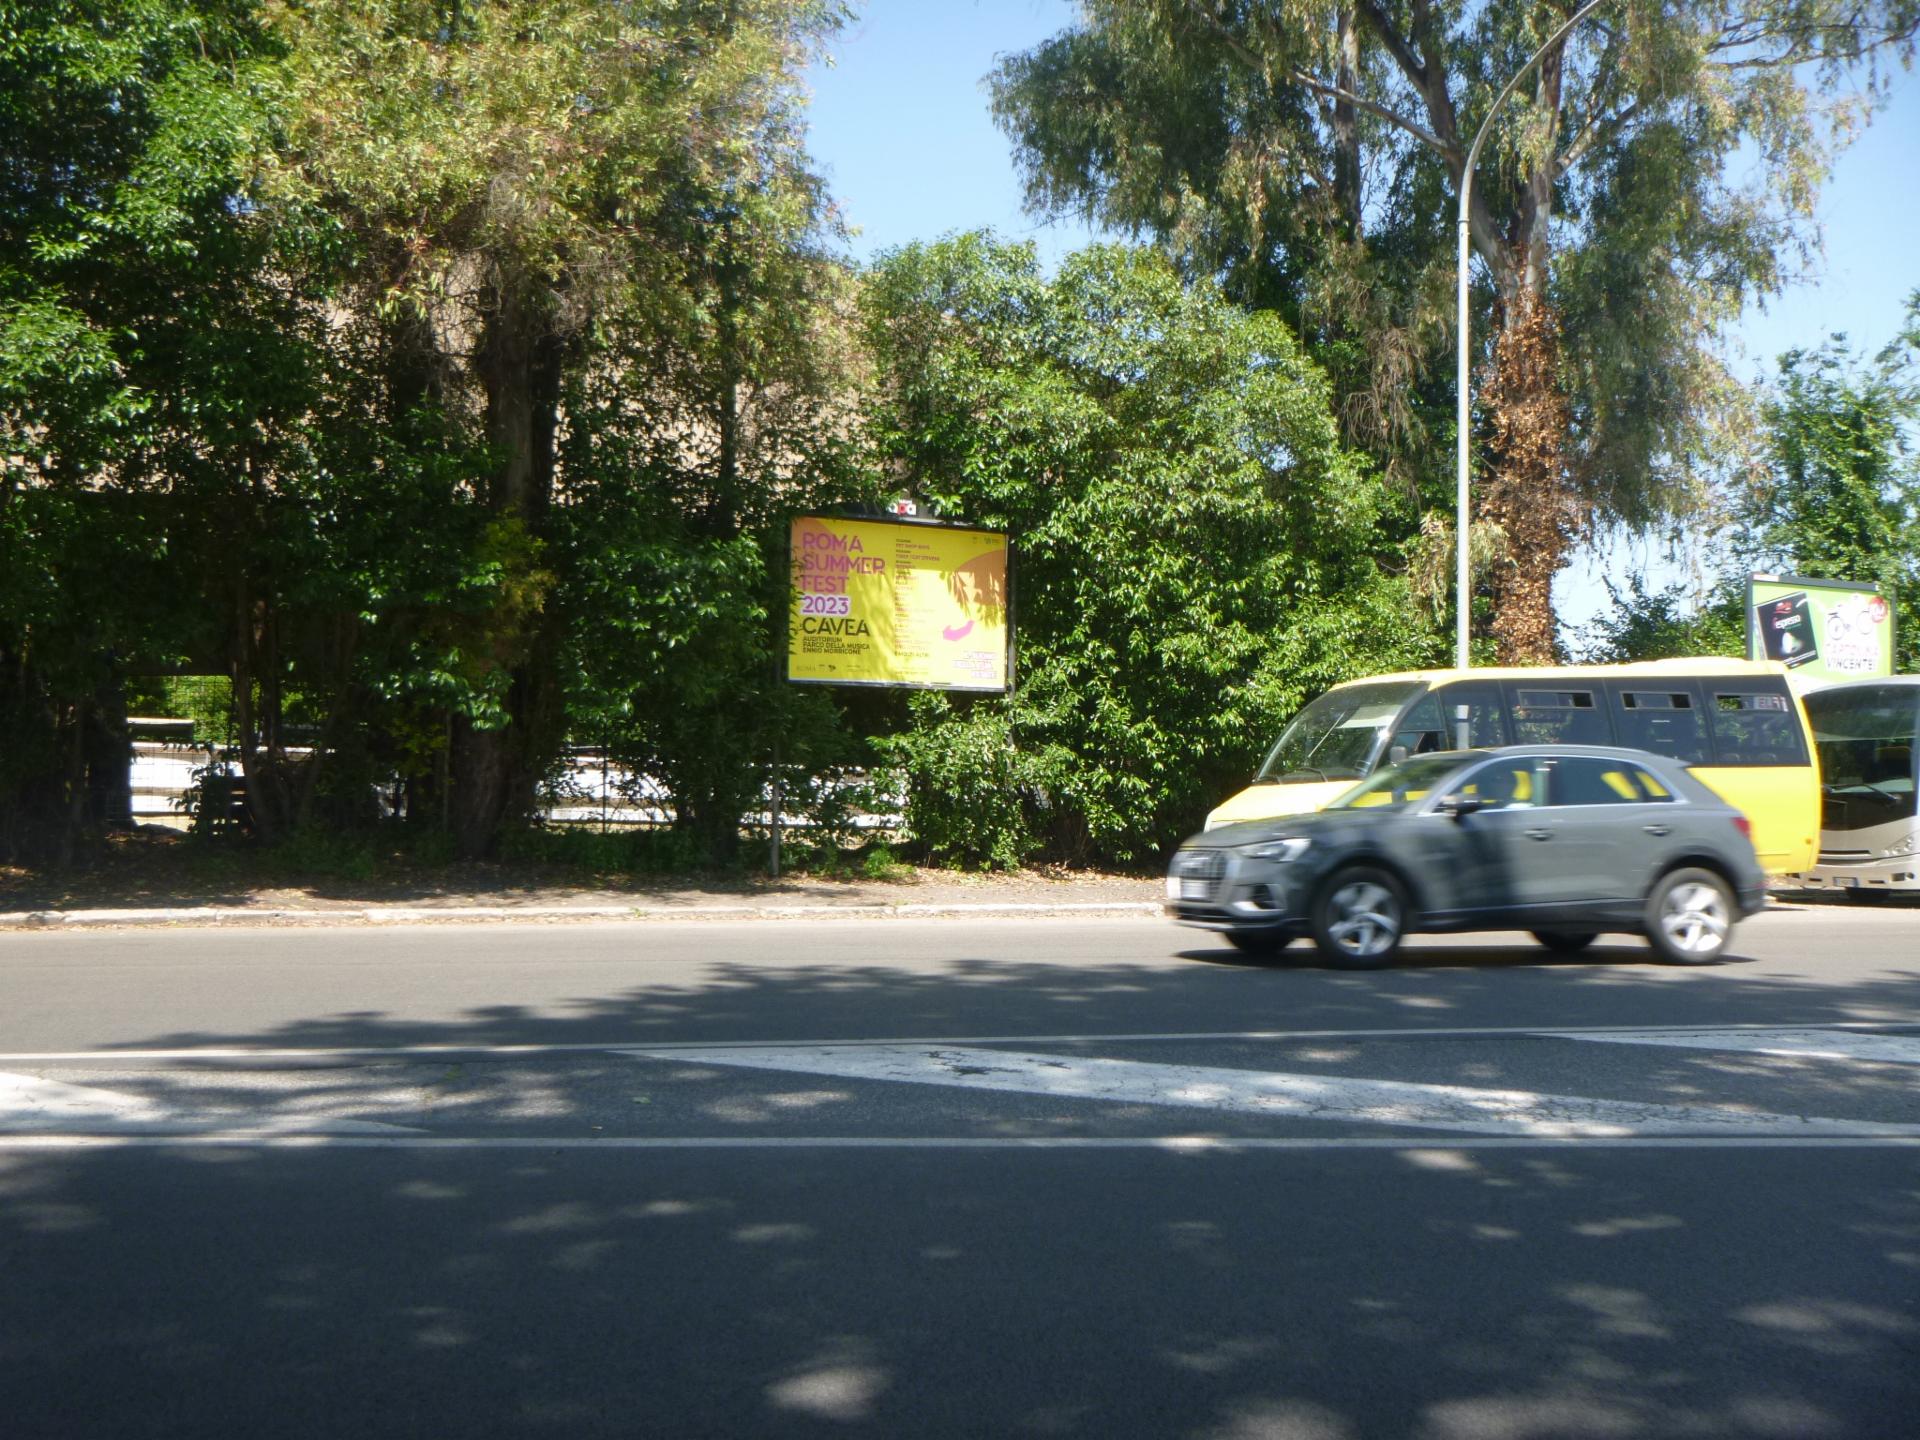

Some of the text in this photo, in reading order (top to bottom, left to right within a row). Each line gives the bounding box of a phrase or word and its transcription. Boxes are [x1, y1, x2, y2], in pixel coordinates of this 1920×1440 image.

[803, 532, 864, 553] ROMA
[803, 553, 886, 575] SUMMER
[802, 574, 849, 594] FEST
[802, 595, 848, 614] 2023
[802, 616, 871, 637] CAVEA
[824, 648, 862, 656] MORRICONE
